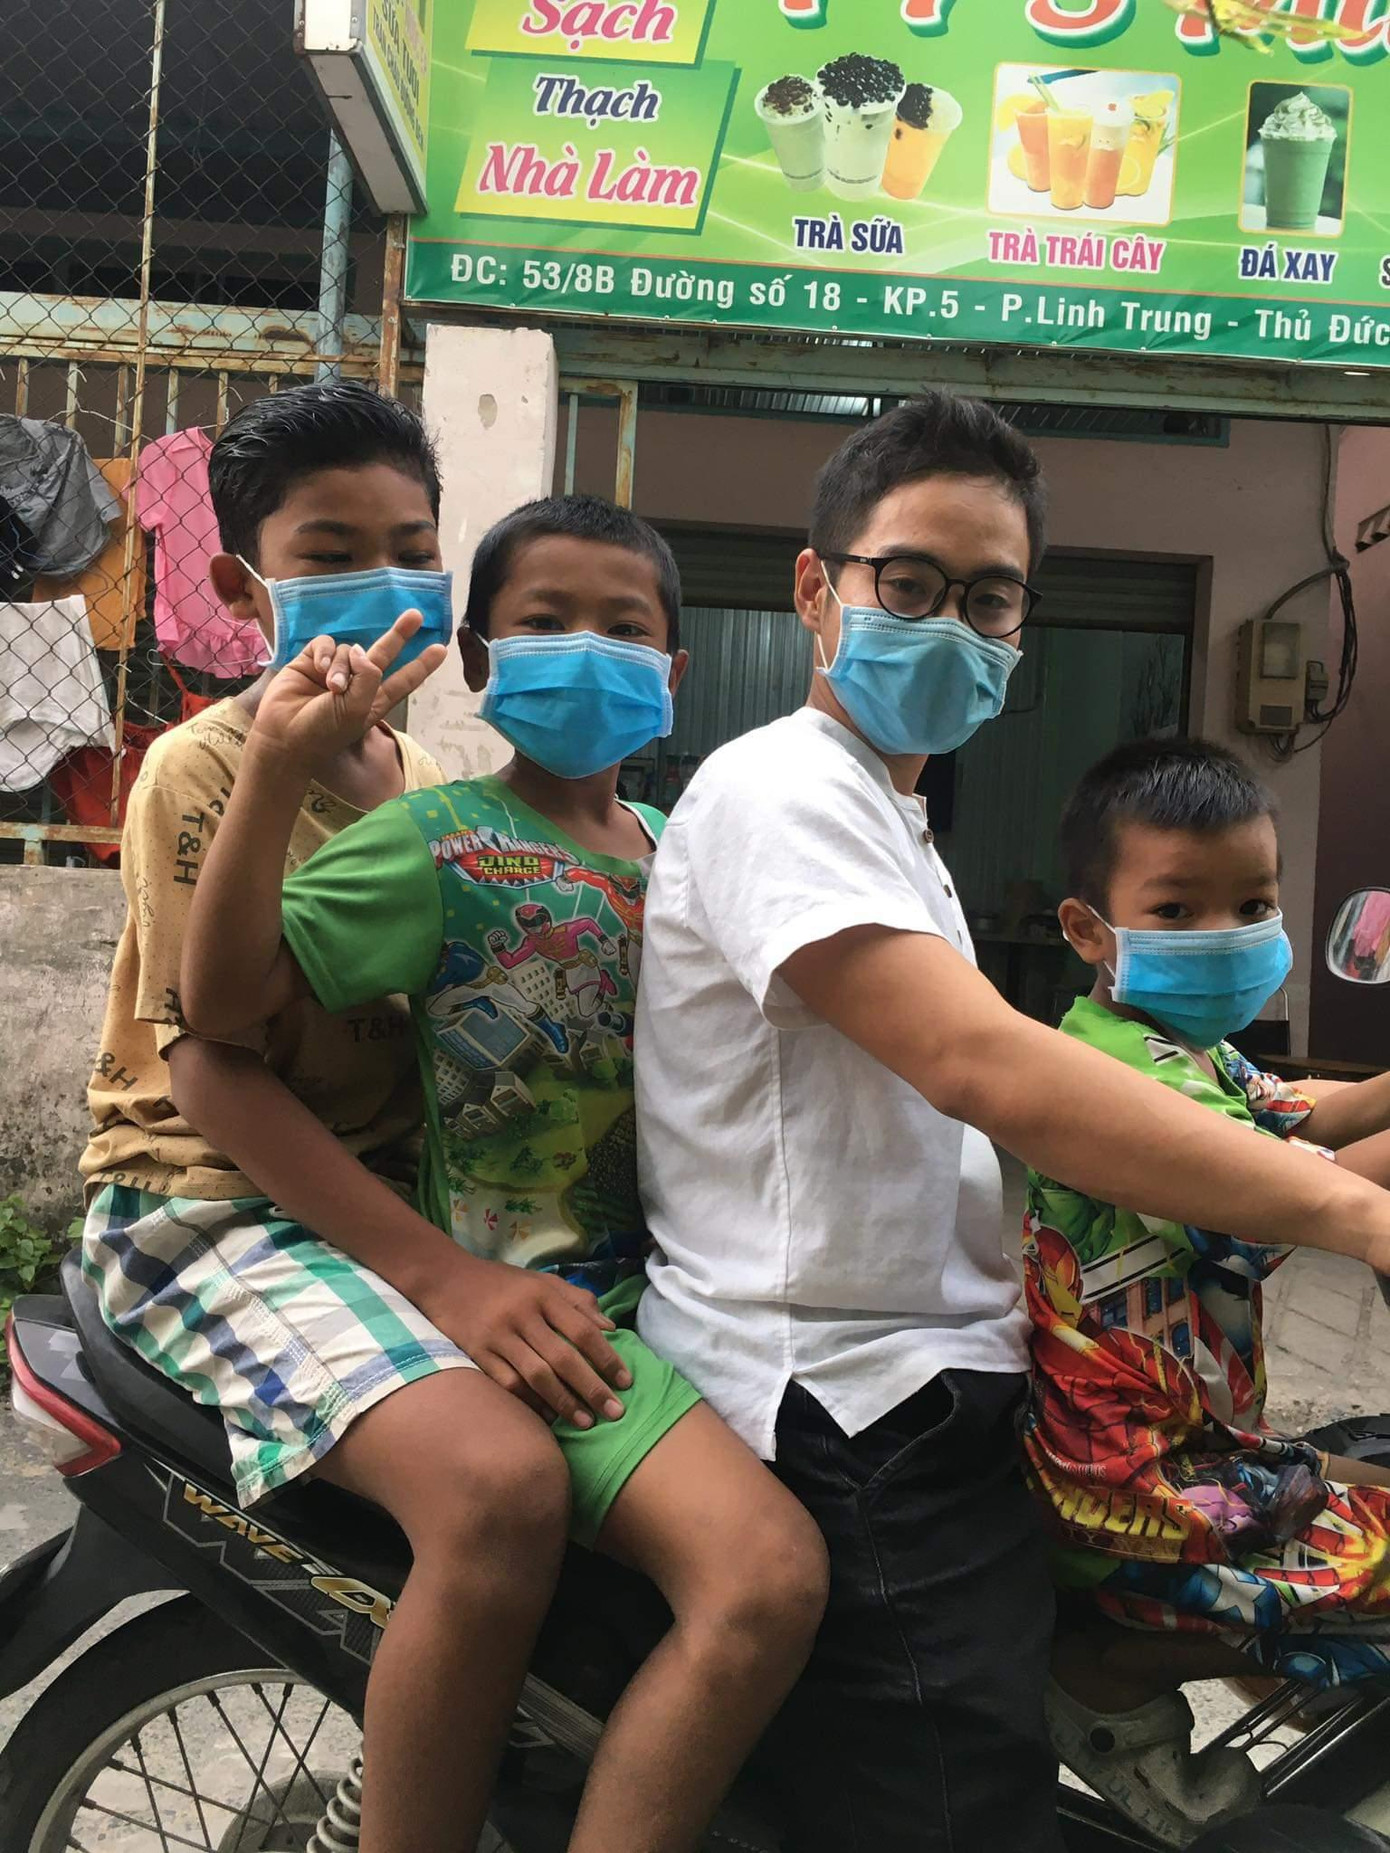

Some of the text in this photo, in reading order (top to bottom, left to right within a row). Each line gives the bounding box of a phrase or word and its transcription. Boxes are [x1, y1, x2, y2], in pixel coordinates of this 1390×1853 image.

[522, 0, 674, 50] Sạch
[535, 76, 660, 128] Thạch
[480, 145, 700, 205] Nhà Làm
[794, 214, 904, 254] TRÀ SỮA
[989, 227, 1164, 271] TRÀ TRÁI CÂY
[1241, 243, 1336, 282] ĐÁ XAY
[451, 254, 507, 287] ĐC:
[522, 260, 614, 296] 53/8B
[631, 267, 734, 308] Đường
[749, 274, 793, 307] số
[803, 280, 841, 312] 18
[883, 285, 960, 319] KP.5
[1001, 293, 1106, 328] P.Linh
[1121, 301, 1212, 341] Trung
[1254, 308, 1312, 342] Thủ
[1328, 314, 1390, 347] Đức
[173, 812, 206, 886] T&H
[429, 832, 580, 866] POWER RANGERS
[483, 865, 542, 876] CHARGE
[183, 1482, 305, 1564] WAVE
